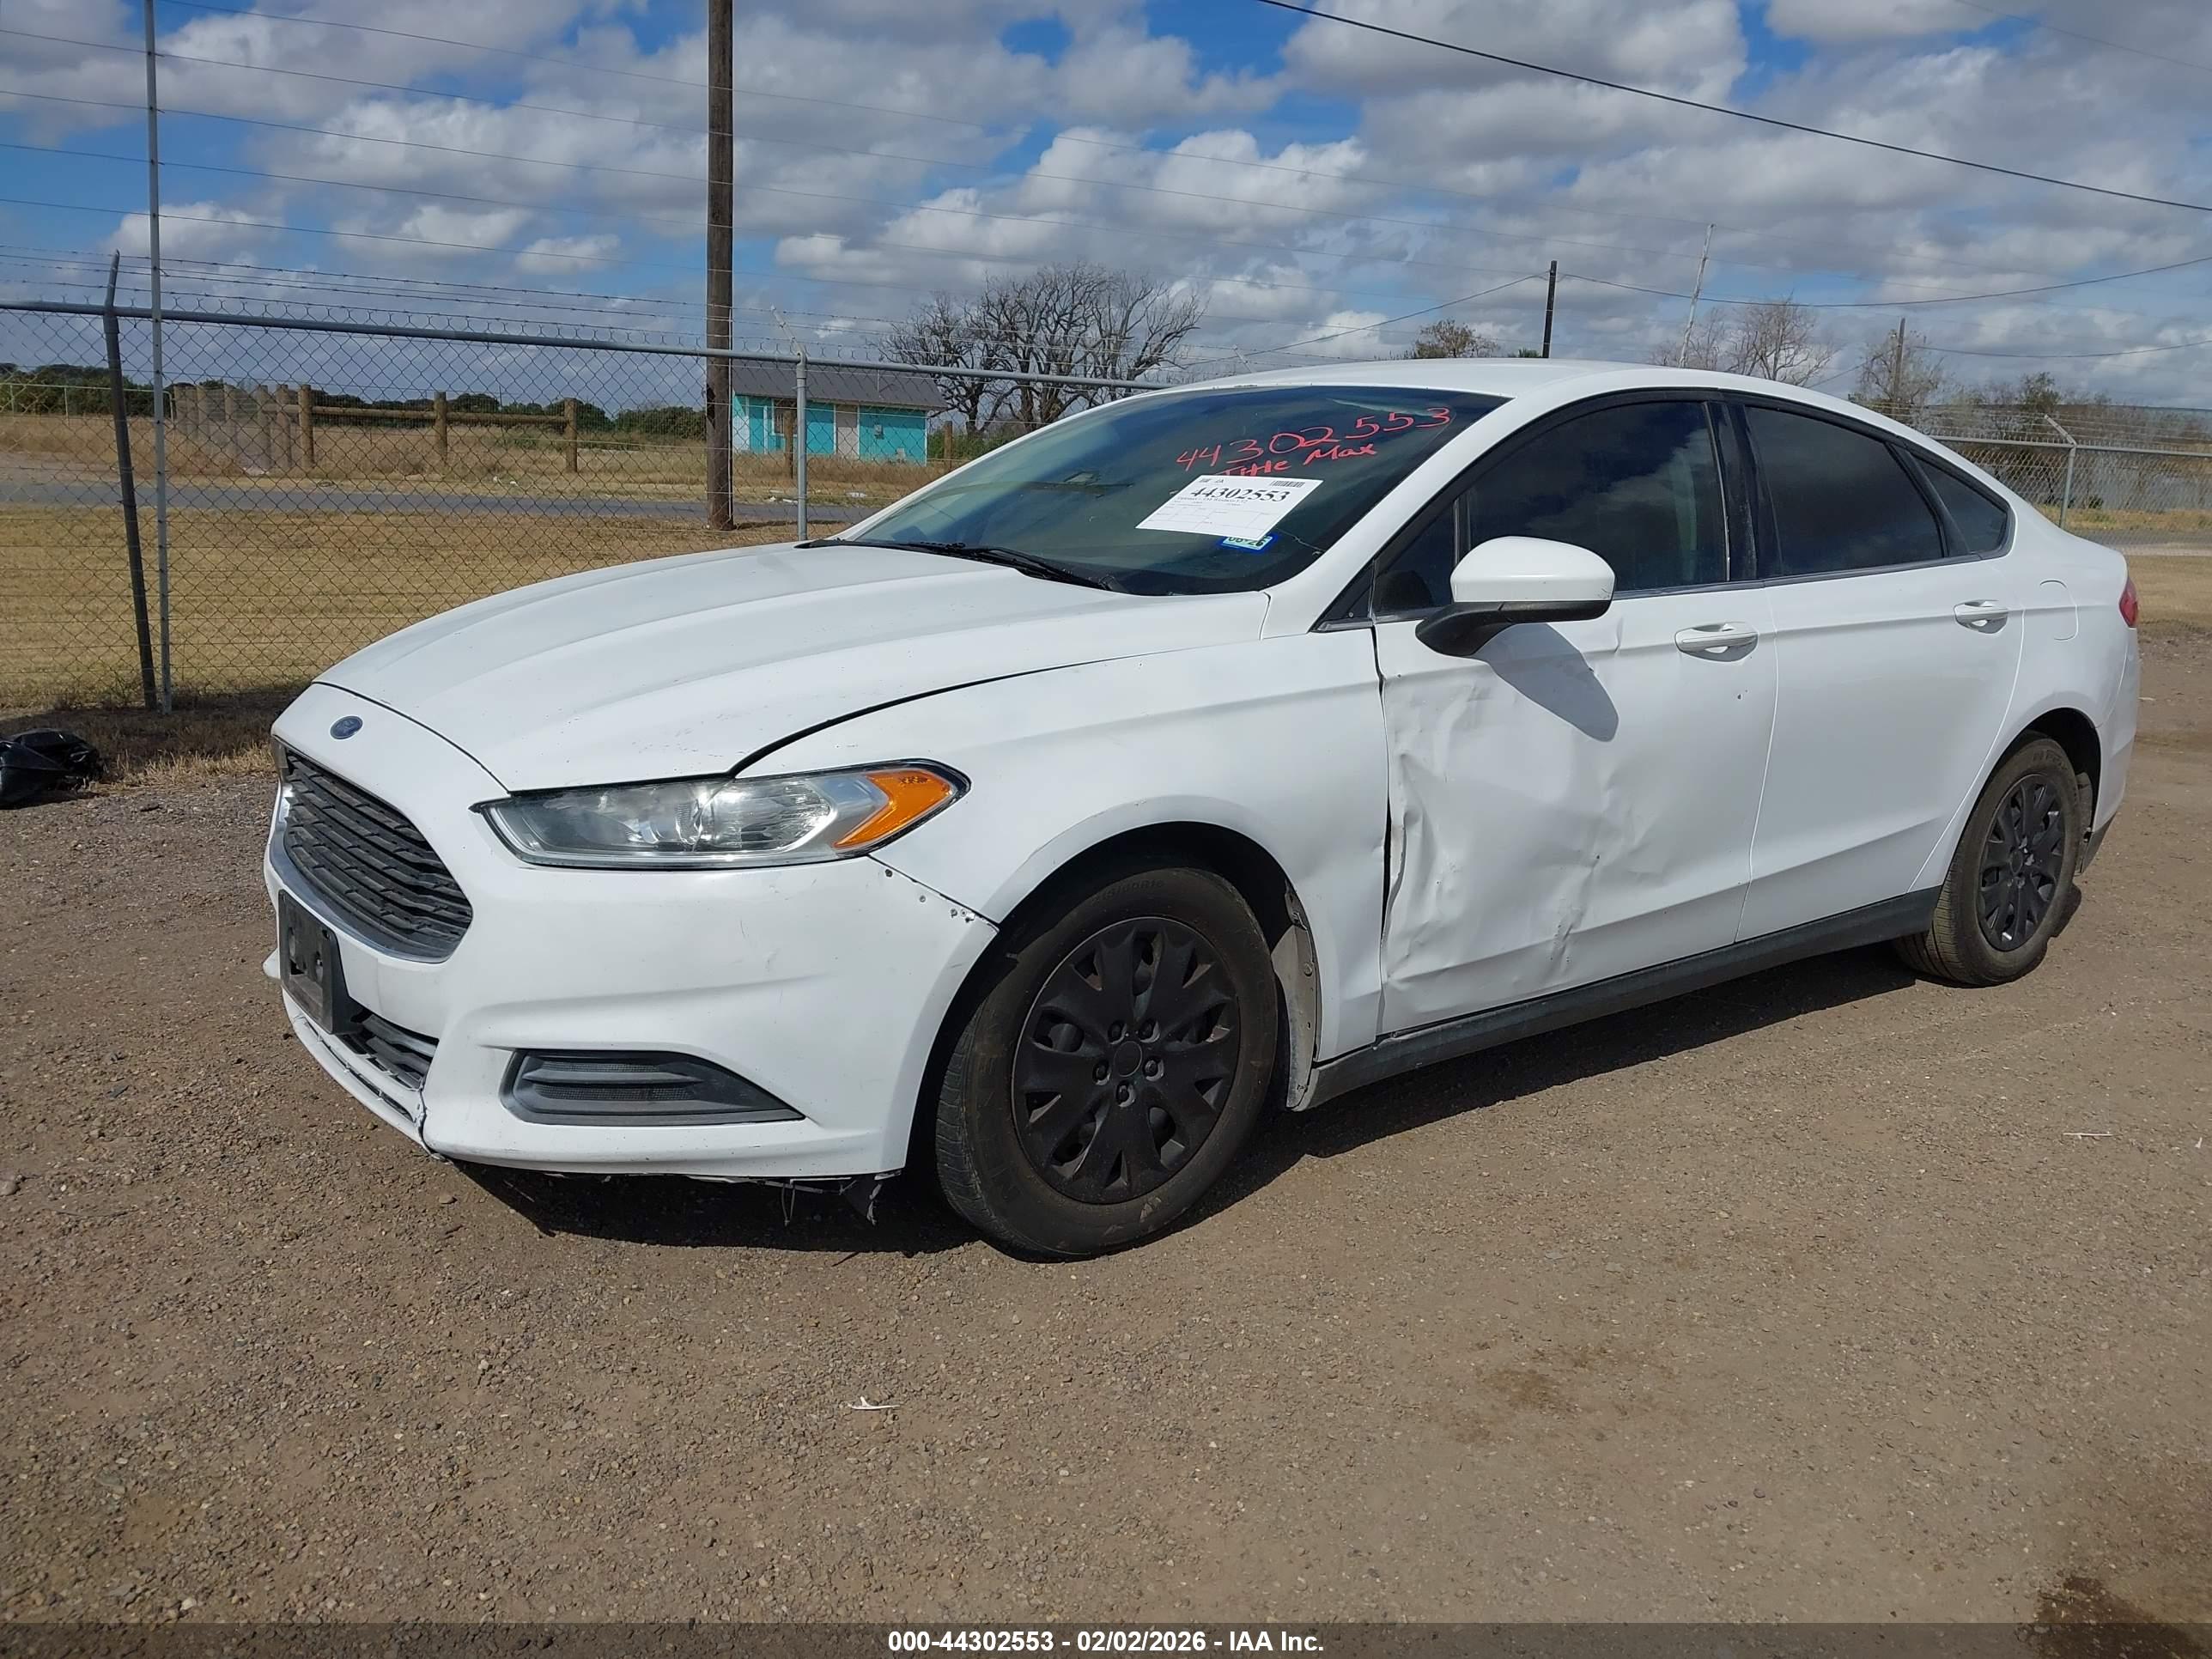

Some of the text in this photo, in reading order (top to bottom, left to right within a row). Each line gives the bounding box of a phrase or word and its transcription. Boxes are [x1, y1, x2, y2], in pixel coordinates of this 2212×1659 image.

[1176, 408, 1450, 471] 44302553
[1303, 444, 1379, 465] Max
[1191, 487, 1291, 502] 44302553
